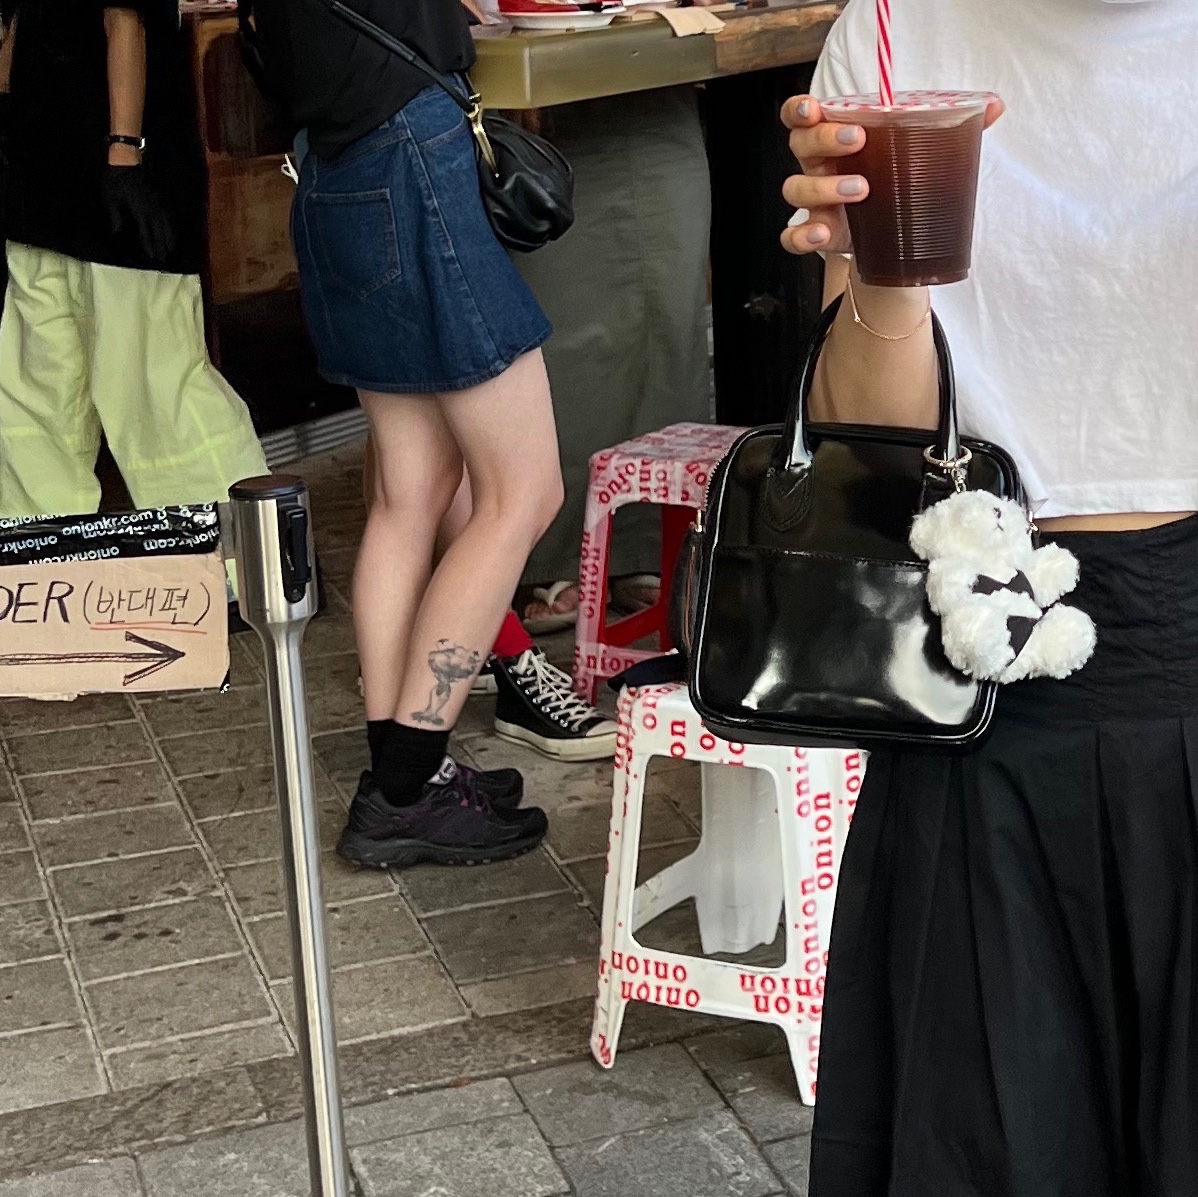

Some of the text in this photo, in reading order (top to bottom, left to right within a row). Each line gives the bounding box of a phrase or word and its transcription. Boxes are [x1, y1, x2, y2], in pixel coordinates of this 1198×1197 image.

[62, 511, 153, 537] onionkr.com
[811, 792, 833, 891] onion
[794, 876, 821, 976] onion
[611, 950, 687, 983] onion
[620, 980, 700, 1008] onion
